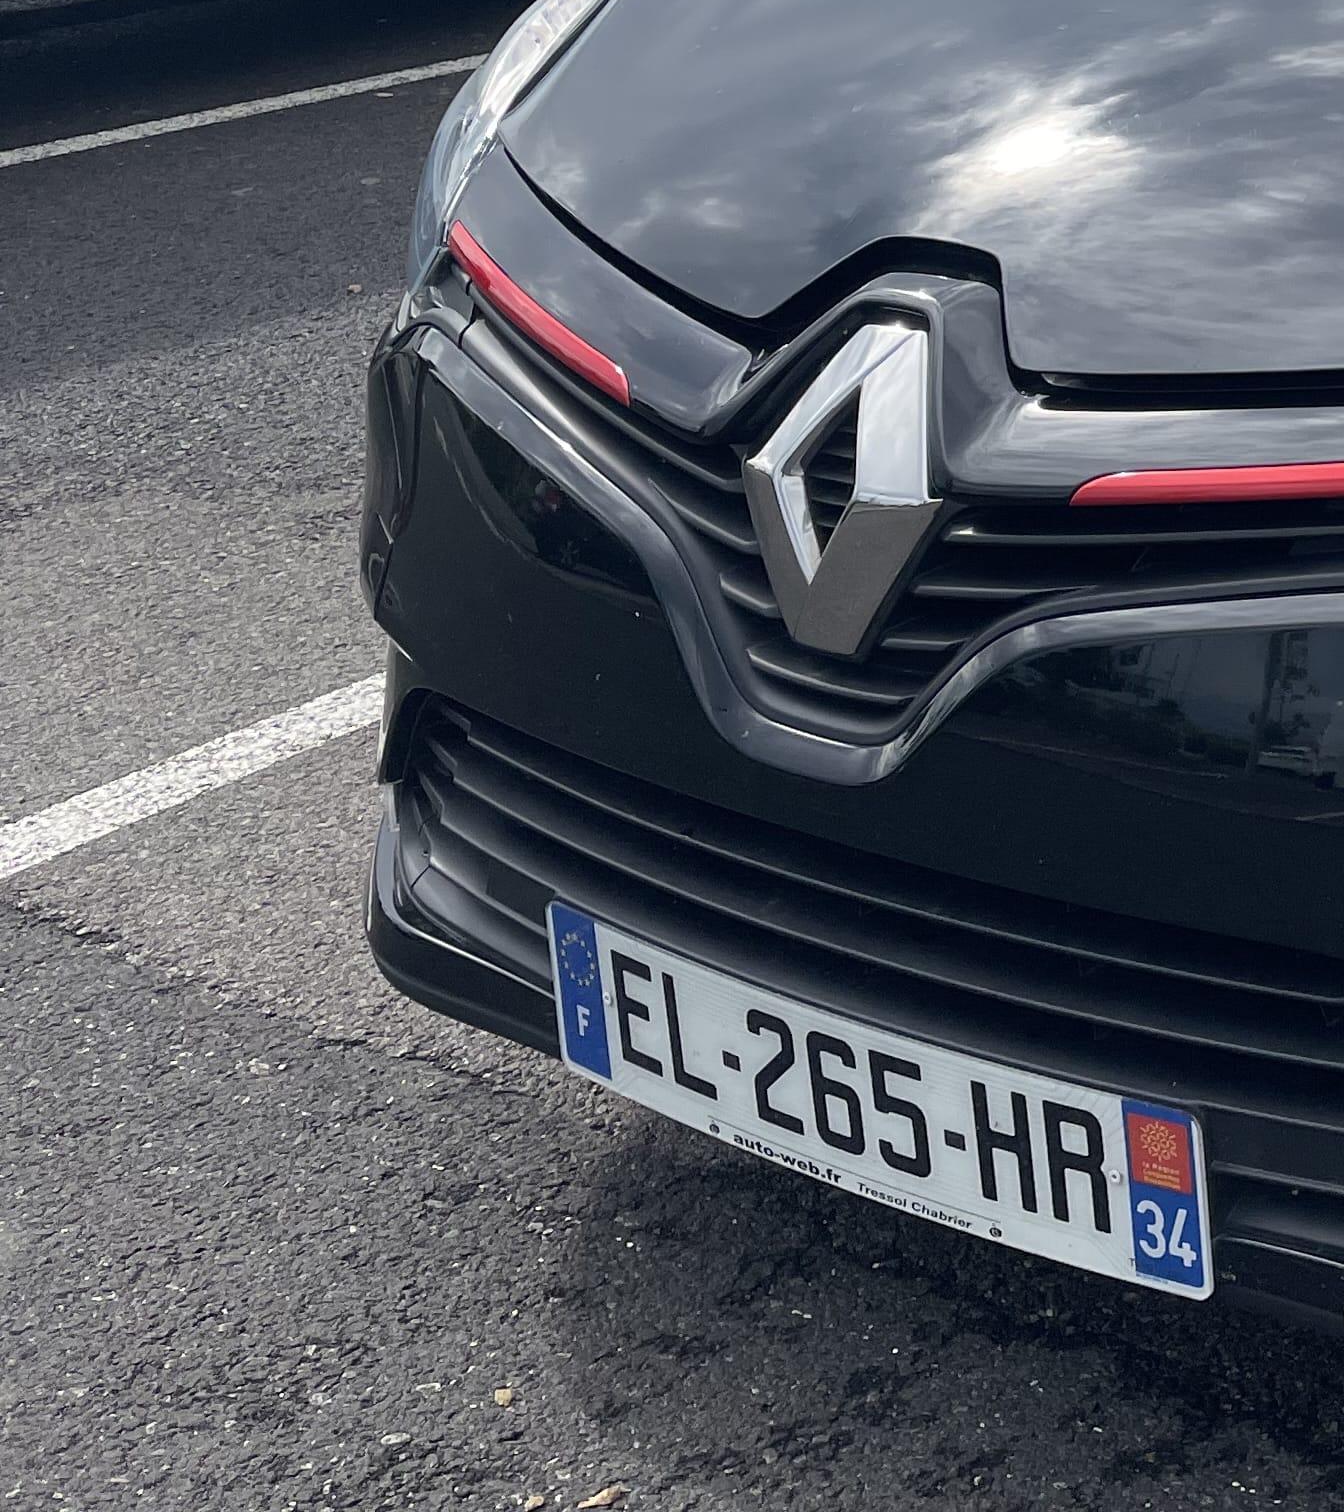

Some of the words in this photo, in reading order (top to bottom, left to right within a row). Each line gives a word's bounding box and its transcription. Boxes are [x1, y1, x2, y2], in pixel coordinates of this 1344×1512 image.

[576, 1004, 591, 1038] F
[610, 949, 1112, 1234] EL-265-HR
[733, 1133, 842, 1185] auto-web.fr
[856, 1181, 907, 1208] Tressol
[911, 1194, 974, 1230] Chabrier
[1137, 1199, 1197, 1268] 34
